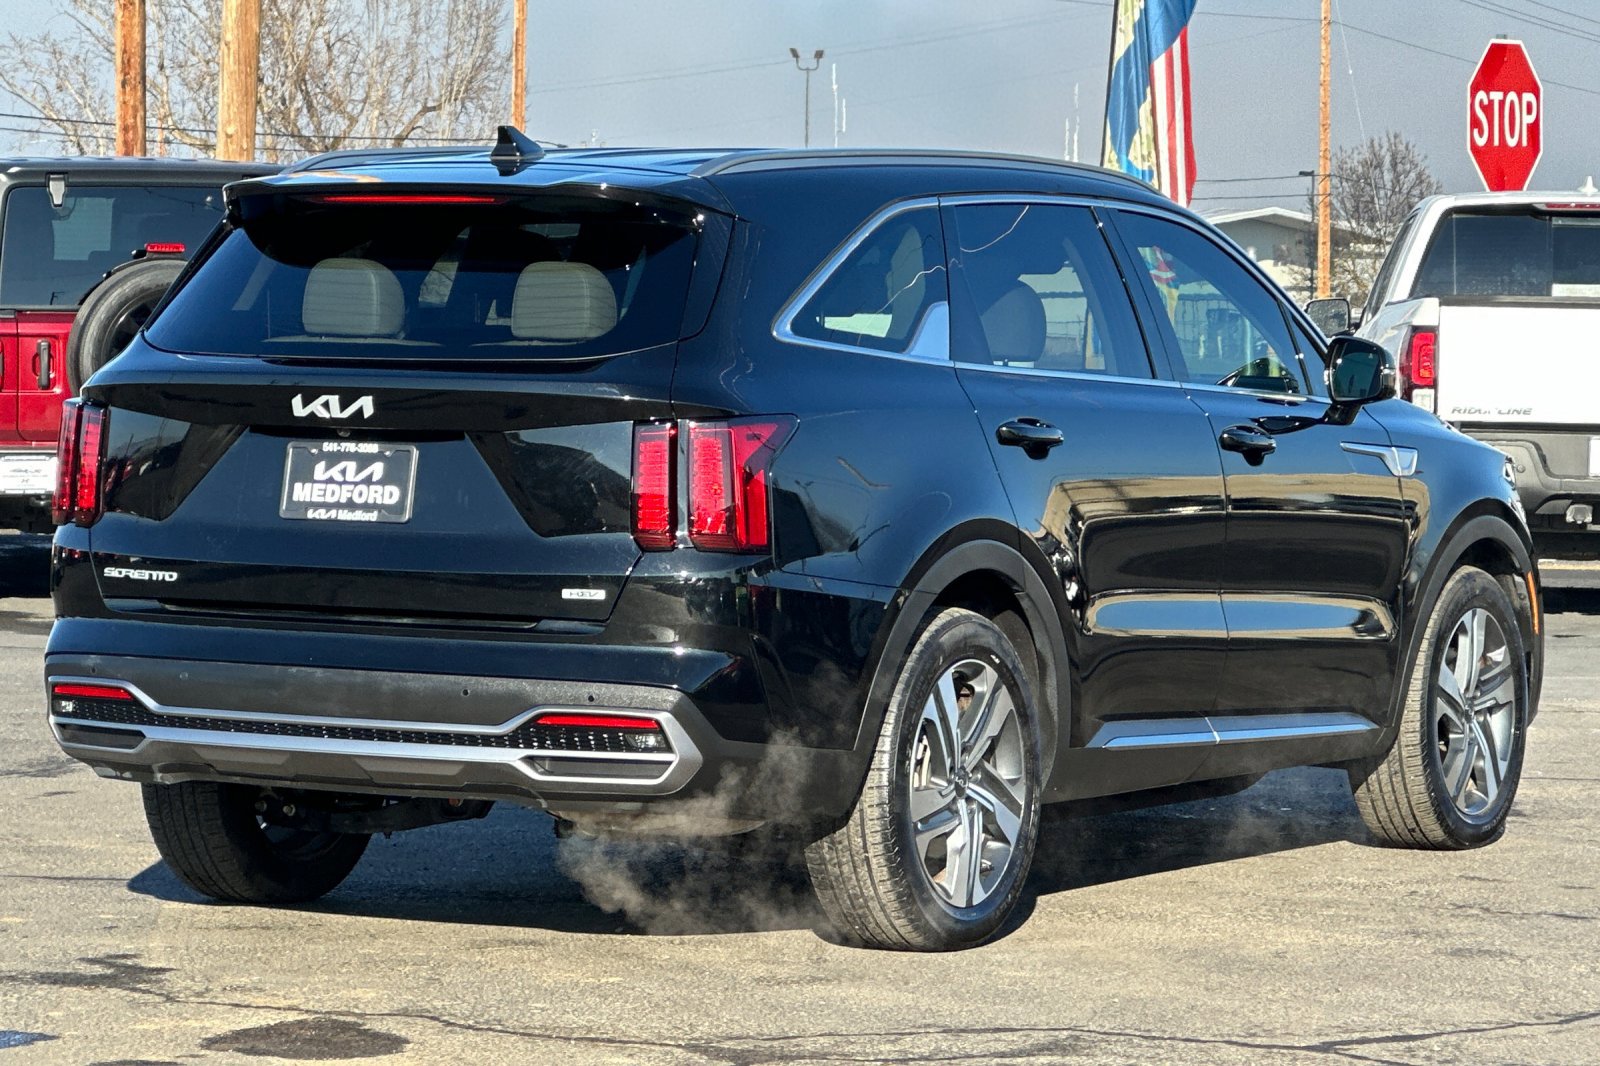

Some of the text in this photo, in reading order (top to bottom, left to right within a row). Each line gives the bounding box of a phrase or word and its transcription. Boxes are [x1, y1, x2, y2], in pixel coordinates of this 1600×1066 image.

[1473, 90, 1537, 148] STOP
[291, 393, 375, 419] KIA
[1451, 406, 1533, 416] RIDLINE
[313, 460, 385, 482] KIA
[292, 482, 400, 505] MEDFORD
[338, 509, 378, 521] Medford
[103, 566, 178, 582] SORENTO
